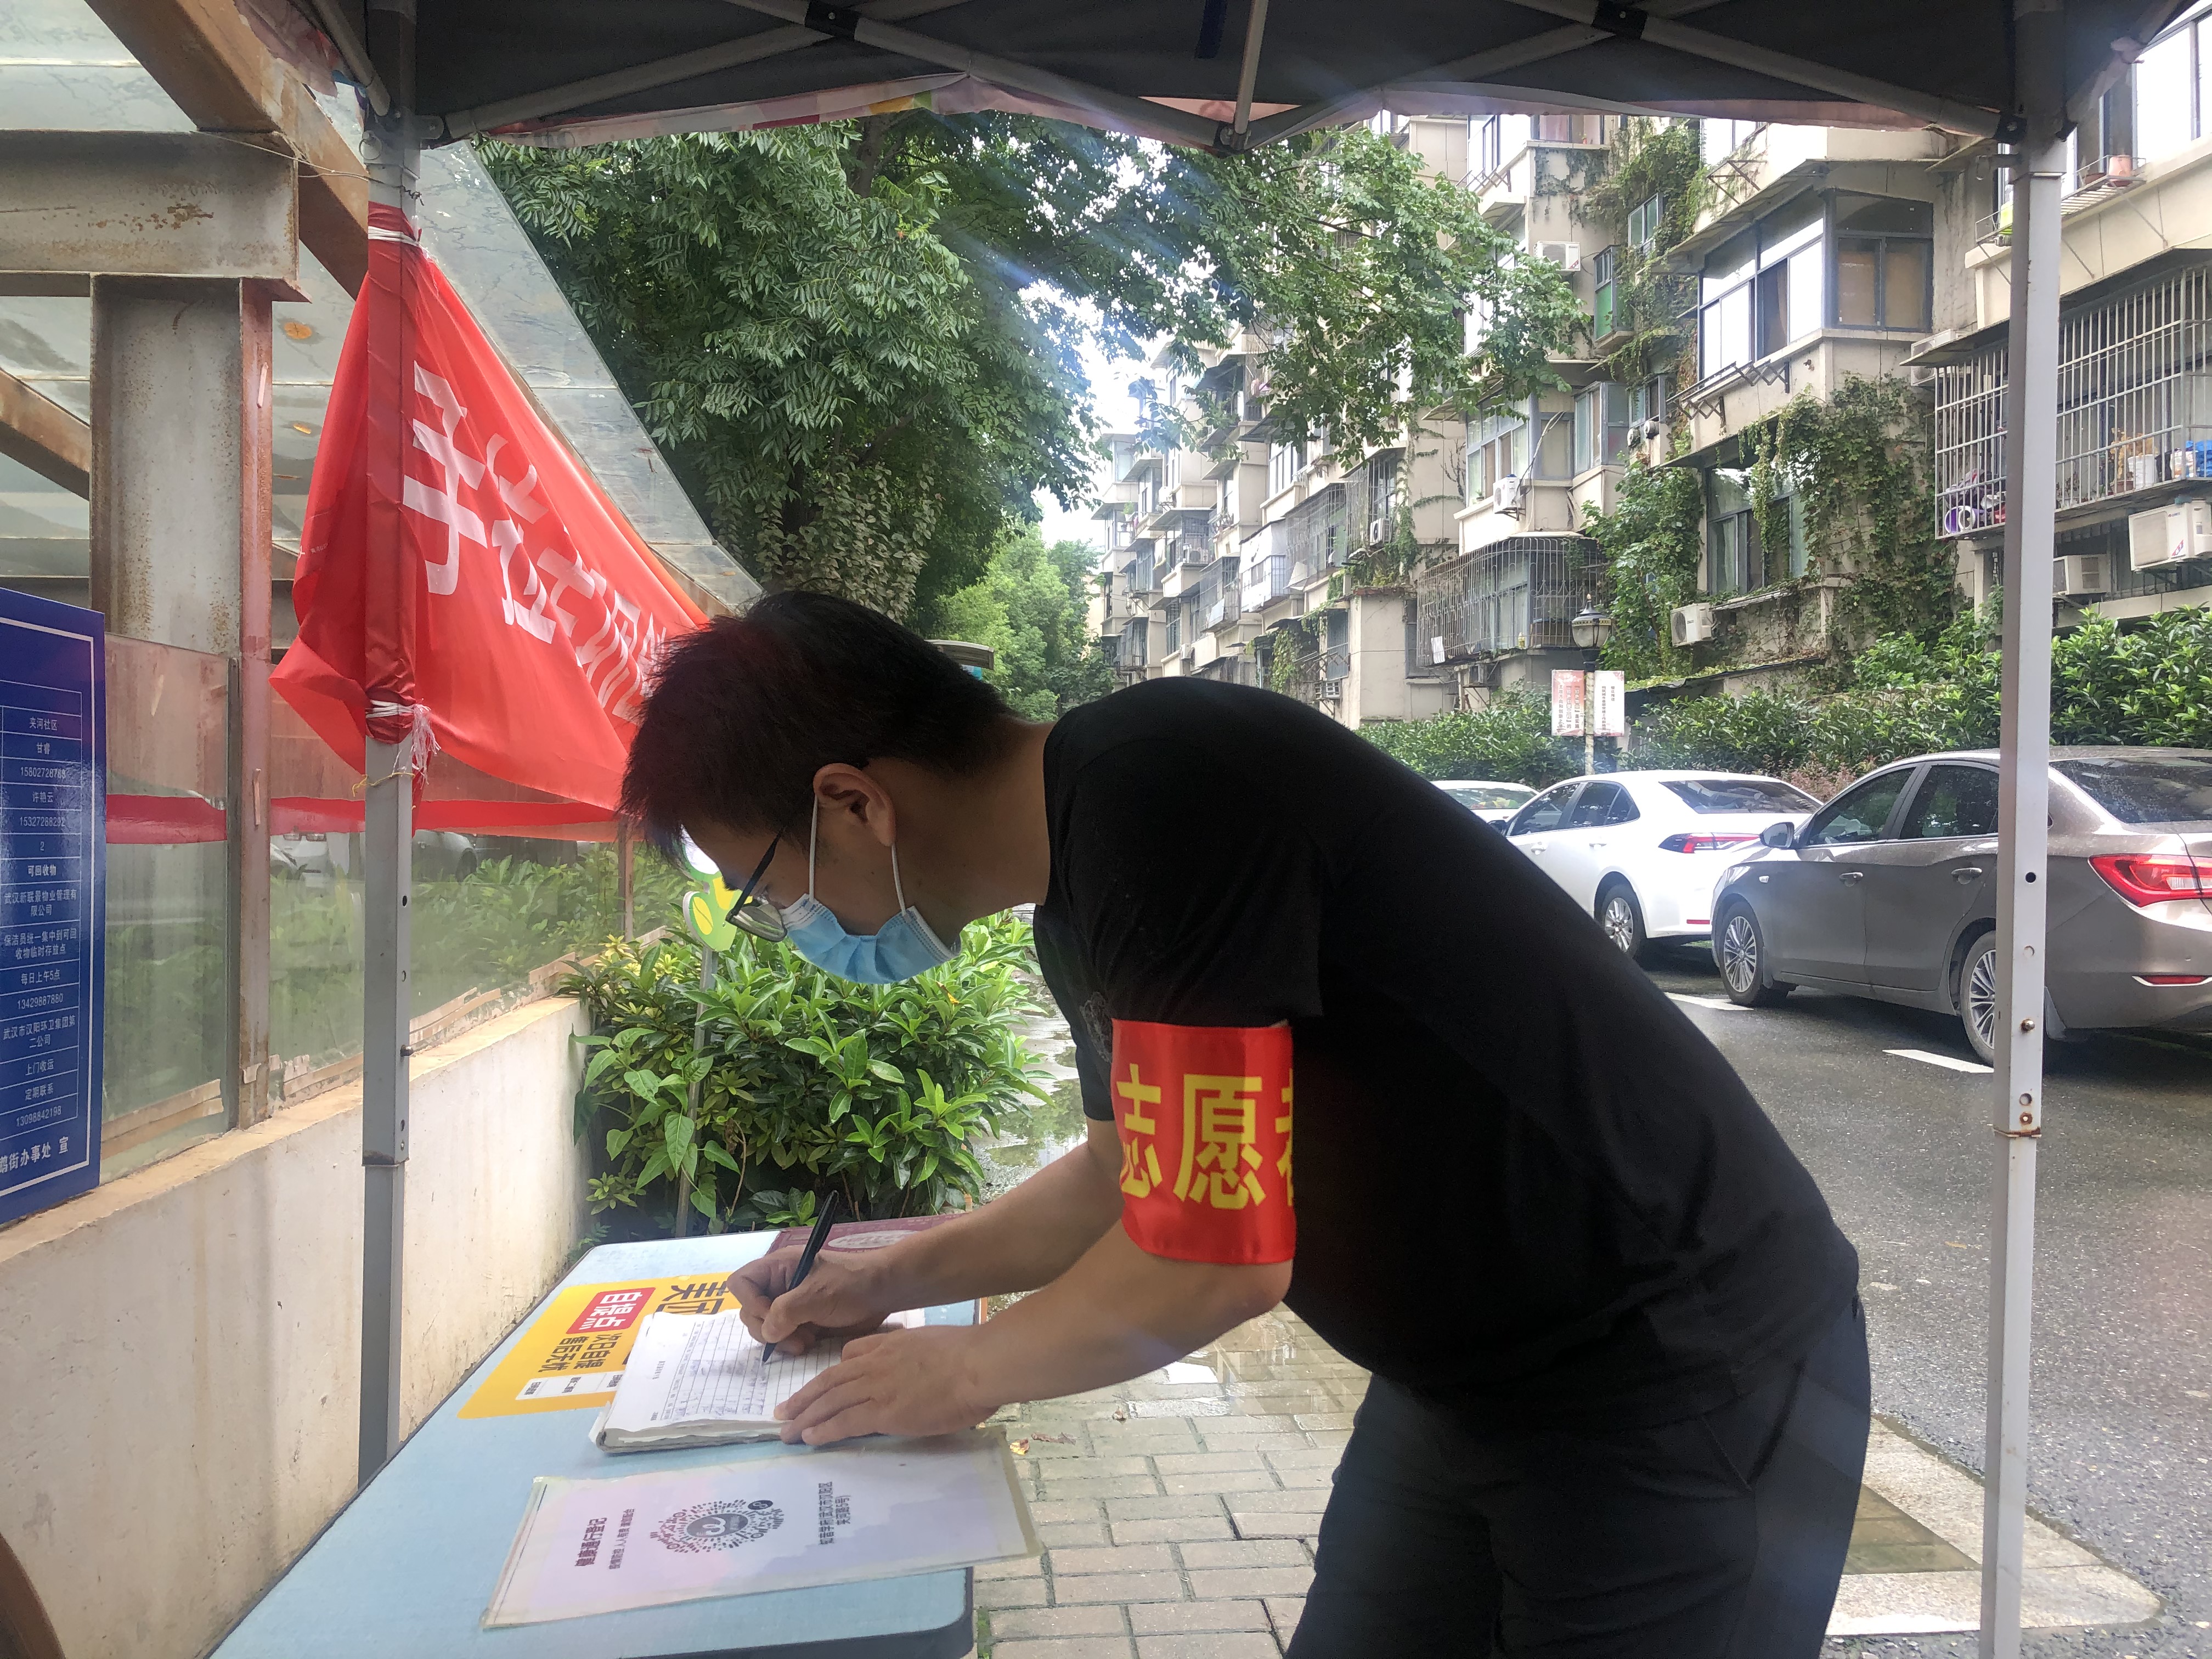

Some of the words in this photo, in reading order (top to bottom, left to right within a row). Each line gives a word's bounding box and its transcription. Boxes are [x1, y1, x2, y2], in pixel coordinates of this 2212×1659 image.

[29, 716, 58, 731] 夹河社区
[40, 841, 45, 851] 2
[27, 864, 57, 877] 可回收物
[31, 904, 53, 917] 限公司
[3, 928, 77, 947] 保洁员统一集中到可回
[15, 943, 66, 960] 收物临时存放点
[20, 968, 61, 985] 每日上午5点
[3, 1014, 76, 1041] 武汉市汉阳环卫集团第
[29, 1034, 52, 1048] 二公司
[25, 1058, 54, 1076] 上门收运
[25, 1082, 54, 1101] 定期联系
[59, 1136, 69, 1154] 宣
[1116, 1063, 1294, 1209] 志愿
[579, 1290, 643, 1330] 自提点
[538, 1336, 590, 1373] 售后无忧
[573, 1333, 623, 1369] 次日自提
